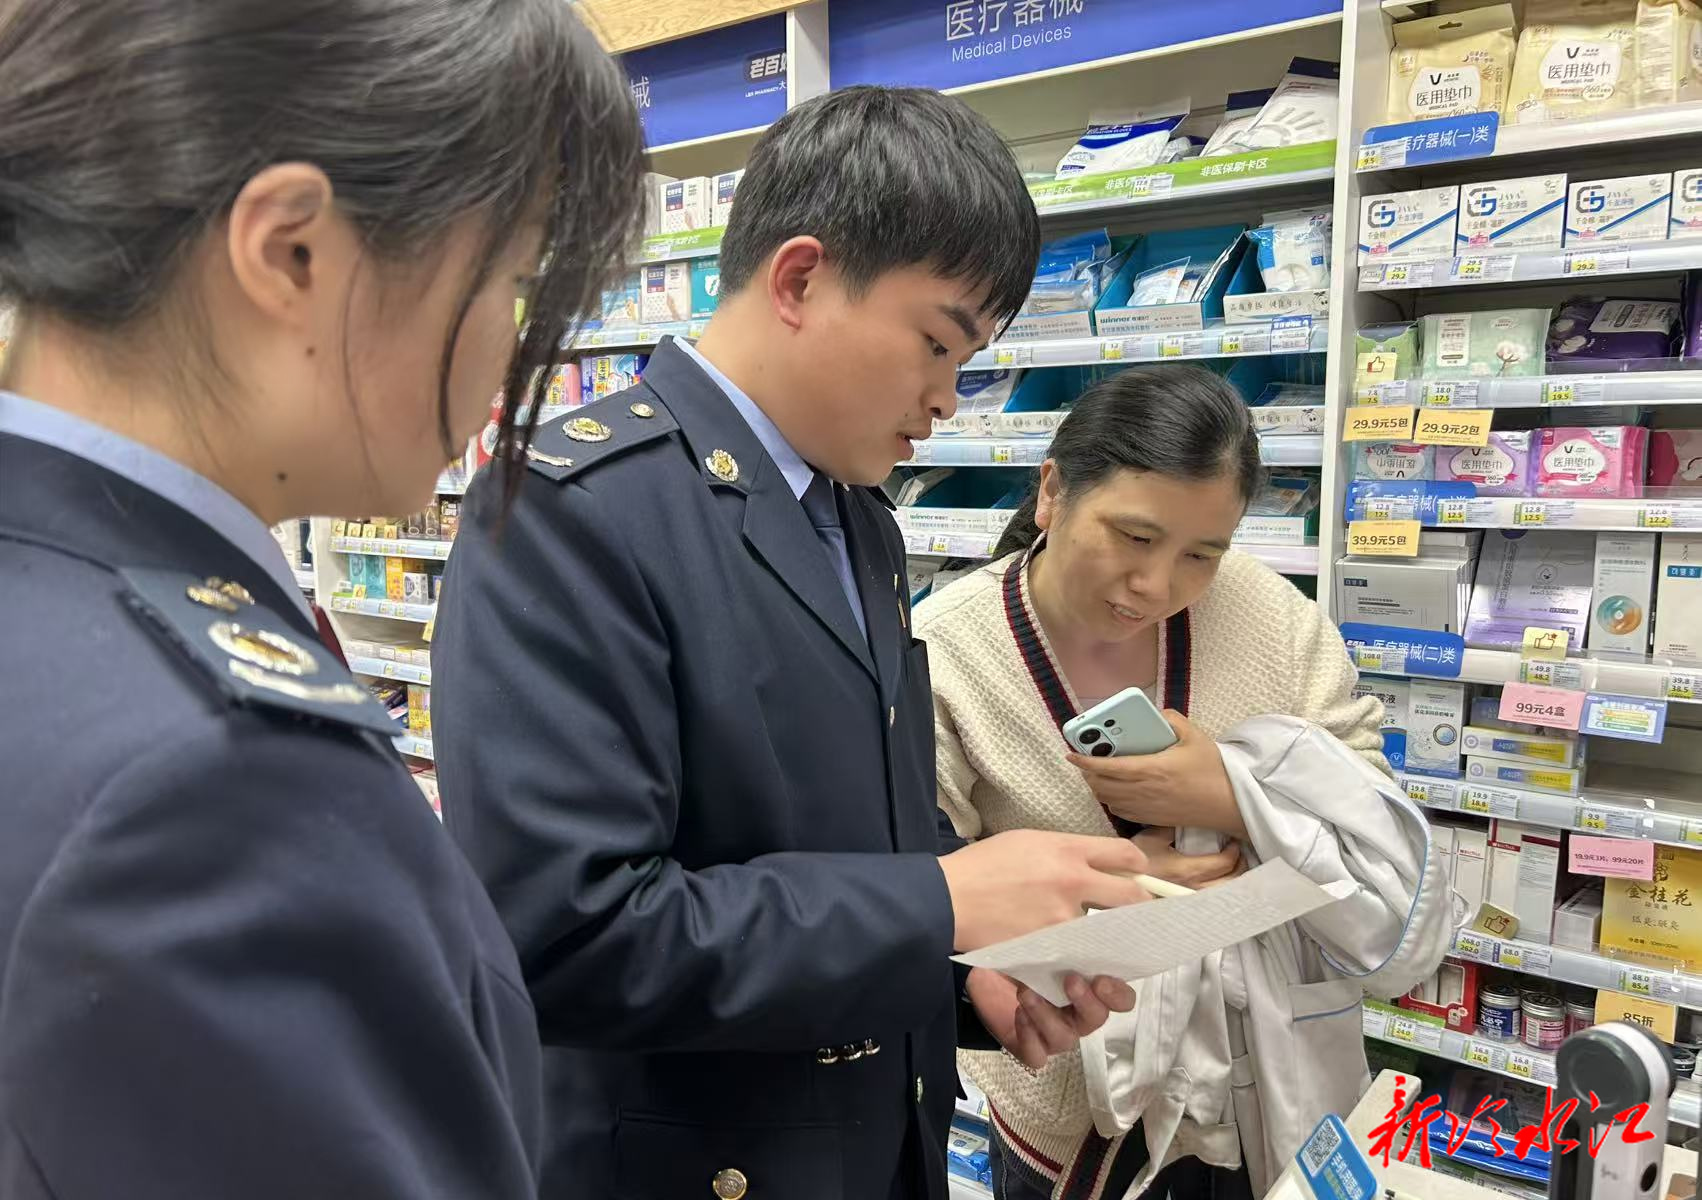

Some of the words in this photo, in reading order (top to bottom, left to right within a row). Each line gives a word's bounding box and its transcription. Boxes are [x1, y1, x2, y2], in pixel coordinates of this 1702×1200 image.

[952, 36, 1006, 62] Medical
[1011, 26, 1072, 49] Devices
[1548, 61, 1611, 79] 医用垫巾
[1416, 85, 1473, 107] 医用垫巾
[1364, 157, 1375, 165] 9.5
[1200, 158, 1269, 177] 非医保刷卡区
[1576, 263, 1595, 271] 29.2
[1353, 418, 1408, 430] 29.9元5包
[1422, 423, 1480, 436] 29.9元2包
[1352, 535, 1407, 545] 39.9元5包
[1671, 685, 1689, 693] 38.5
[1516, 702, 1566, 717] 99元4盒
[1409, 792, 1426, 800] 19.6
[1586, 821, 1599, 829] 9.5
[1625, 882, 1692, 907] 金桂花
[1460, 944, 1479, 954] 262.0
[1503, 948, 1519, 956] 68.0
[1632, 973, 1649, 982] 88.0
[1631, 982, 1649, 990] 85.4
[1623, 1012, 1656, 1028] 85折
[1473, 1053, 1488, 1062] 16.0
[1512, 1064, 1528, 1073] 16.0
